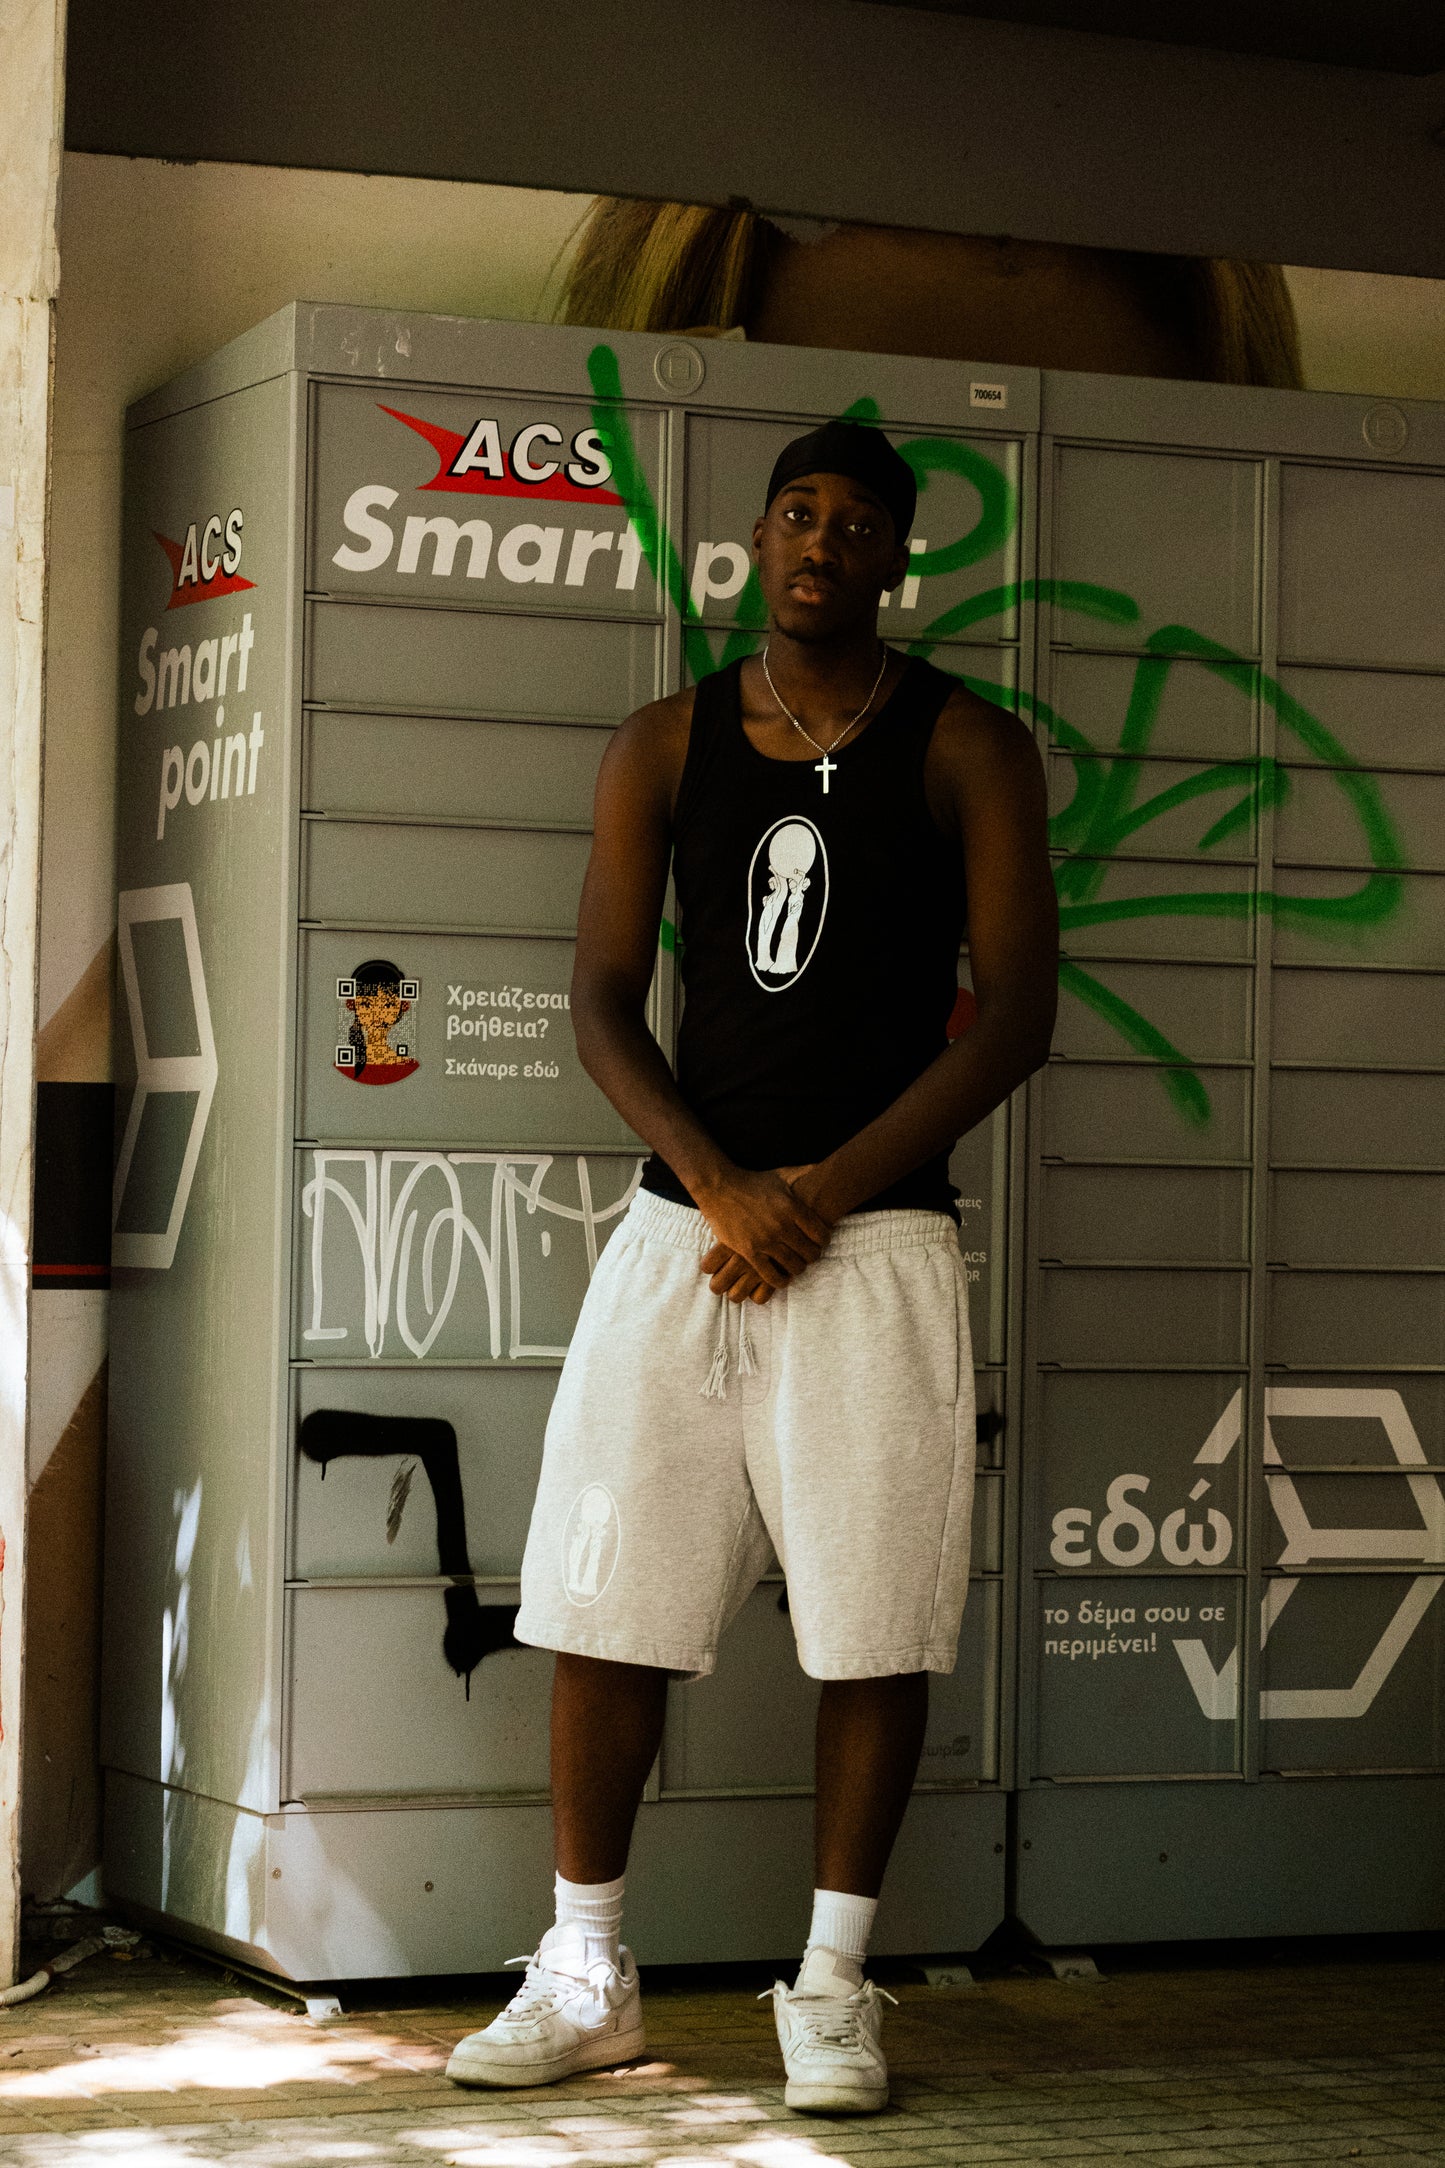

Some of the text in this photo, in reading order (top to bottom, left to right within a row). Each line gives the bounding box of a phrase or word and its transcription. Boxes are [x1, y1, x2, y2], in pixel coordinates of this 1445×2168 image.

[974, 389, 1001, 400] 700654
[446, 418, 616, 489] ACS
[176, 507, 244, 591] ACS
[332, 484, 648, 591] Smart
[134, 613, 255, 717] Smart
[156, 704, 265, 841] point
[446, 985, 570, 1012] Χρειάζεσαι
[446, 1014, 550, 1042] βοήθεια?
[444, 1058, 560, 1080] Σκάναρε εδώ
[963, 1251, 987, 1263] ACS
[1049, 1473, 1233, 1567] εδώ
[1044, 1600, 1225, 1630] το δέμα σου σε
[1044, 1632, 1157, 1661] περιμένει!
